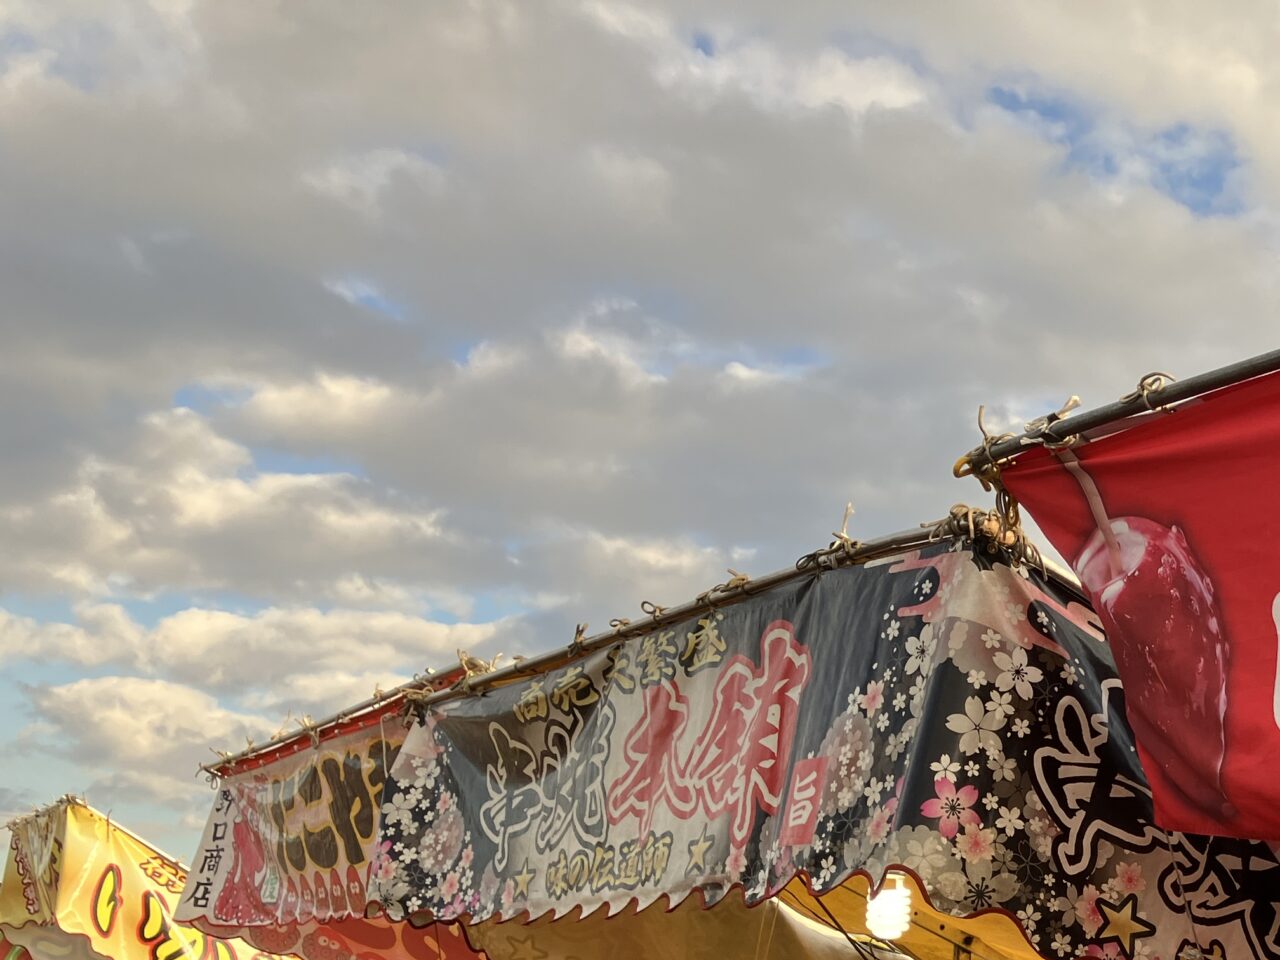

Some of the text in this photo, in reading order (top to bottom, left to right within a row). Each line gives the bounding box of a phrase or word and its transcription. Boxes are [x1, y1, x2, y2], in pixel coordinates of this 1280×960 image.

[512, 617, 729, 724] 商売大繁盛
[787, 769, 818, 829] 旨
[183, 788, 236, 909] 野口商店
[546, 829, 673, 901] 味の伝道師
